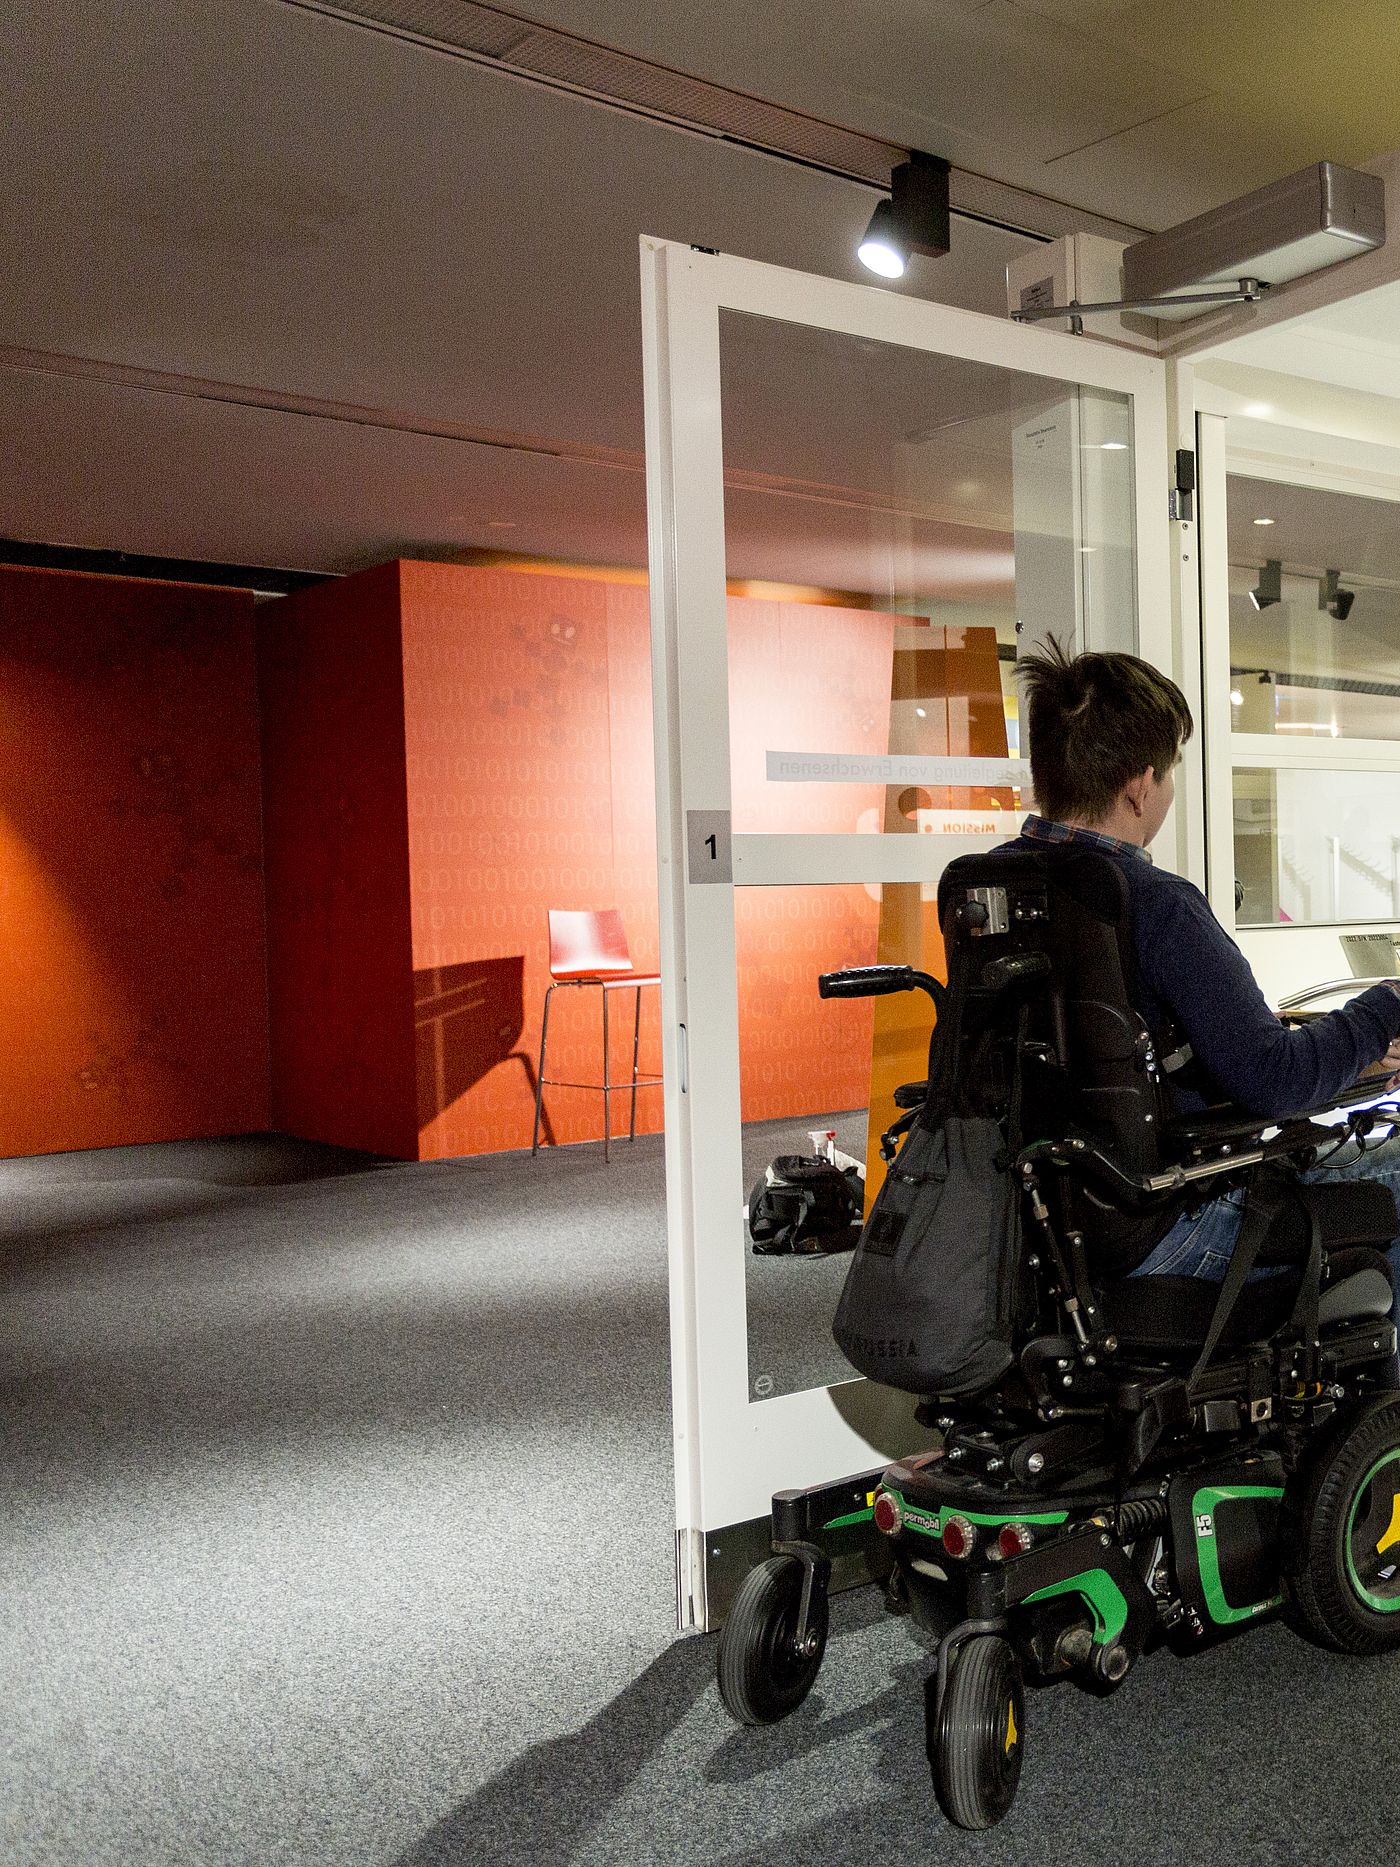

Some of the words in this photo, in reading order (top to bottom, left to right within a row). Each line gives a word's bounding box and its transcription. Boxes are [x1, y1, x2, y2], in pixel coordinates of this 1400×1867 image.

[704, 834, 717, 860] 1
[904, 1511, 940, 1530] permobil
[1196, 1514, 1213, 1537] F5
